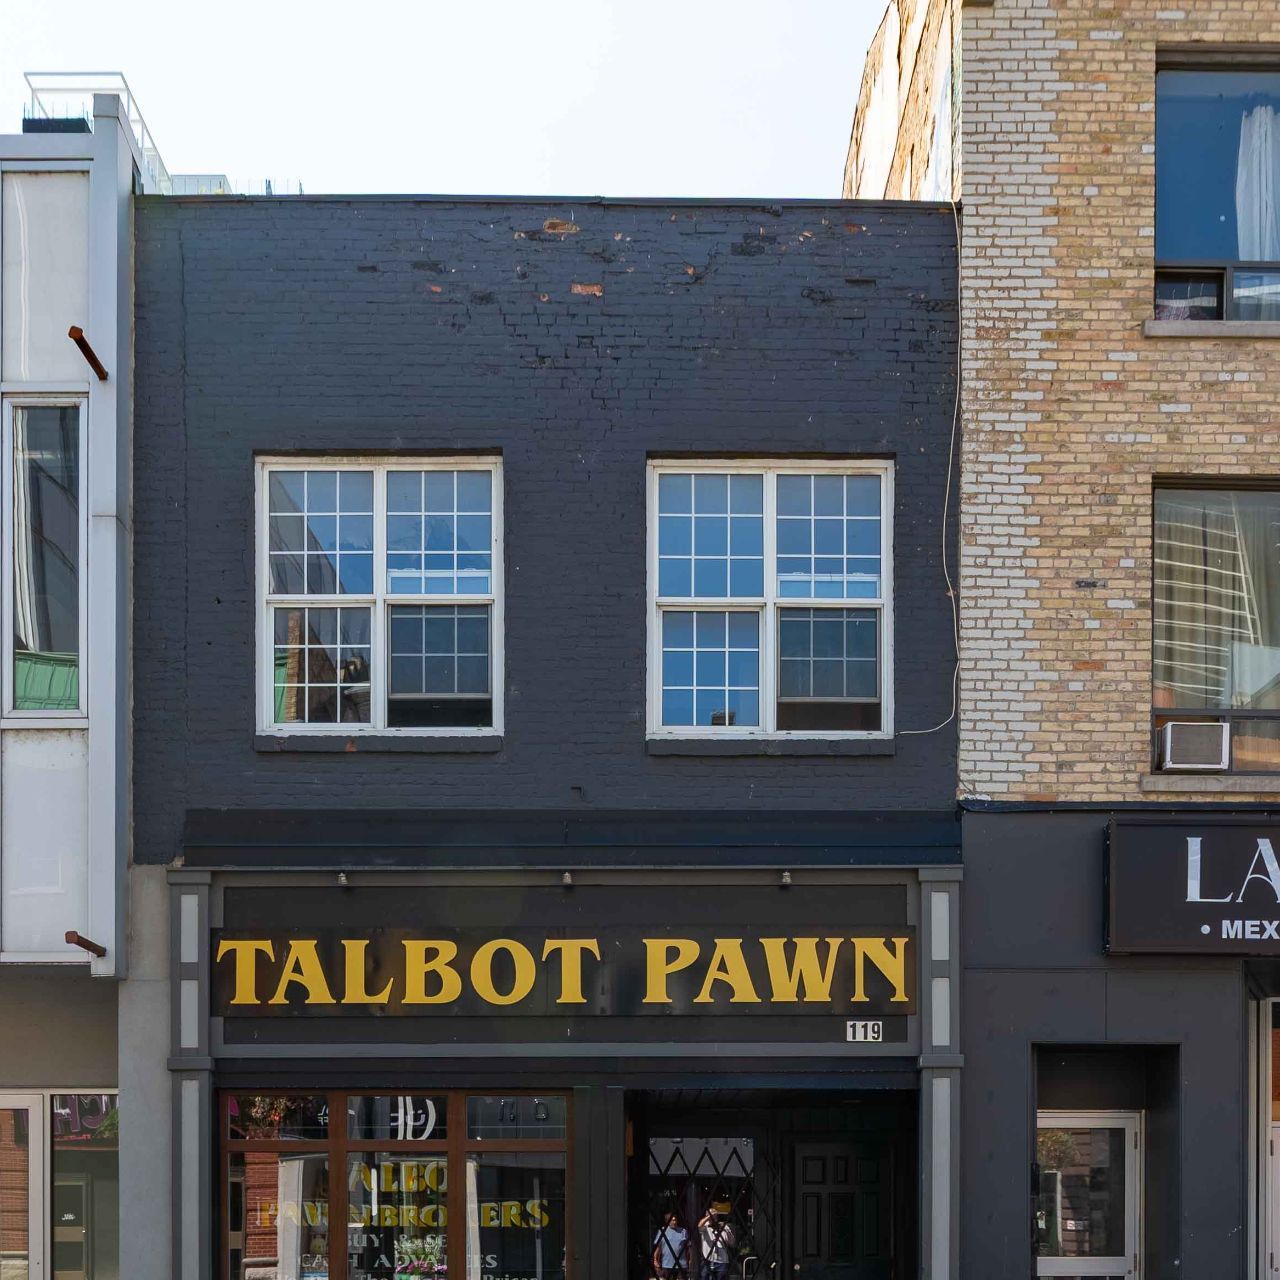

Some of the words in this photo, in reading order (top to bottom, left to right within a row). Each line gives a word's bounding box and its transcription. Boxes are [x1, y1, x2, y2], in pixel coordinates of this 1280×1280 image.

[216, 938, 601, 1006] TALBOT
[641, 937, 910, 1004] PAWN
[848, 1021, 881, 1041] 119
[425, 1233, 448, 1248] SE
[299, 1253, 358, 1268] CAH
